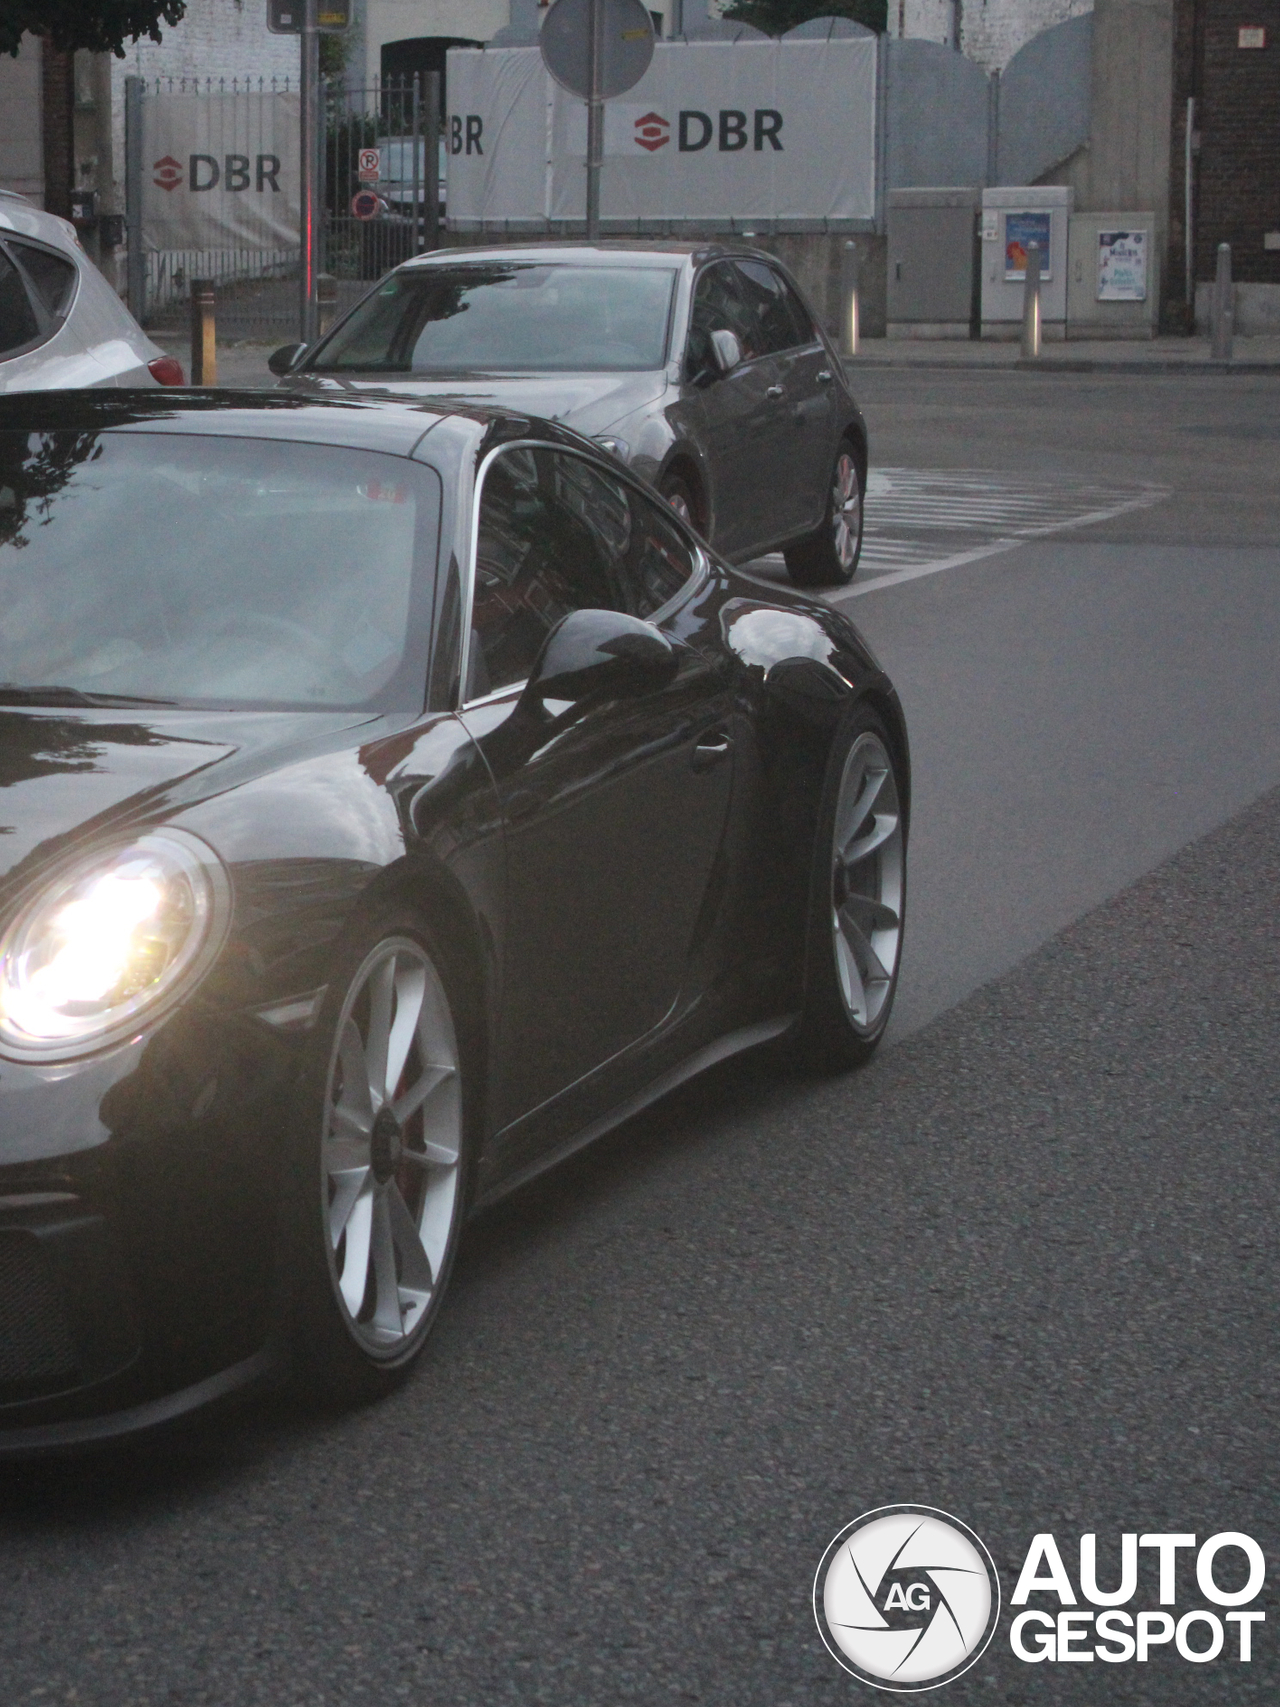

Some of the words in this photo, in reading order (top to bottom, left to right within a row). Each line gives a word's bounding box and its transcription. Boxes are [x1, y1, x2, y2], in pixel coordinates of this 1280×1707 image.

[449, 115, 484, 155] BR
[677, 109, 784, 151] DBR
[189, 154, 281, 192] DBR
